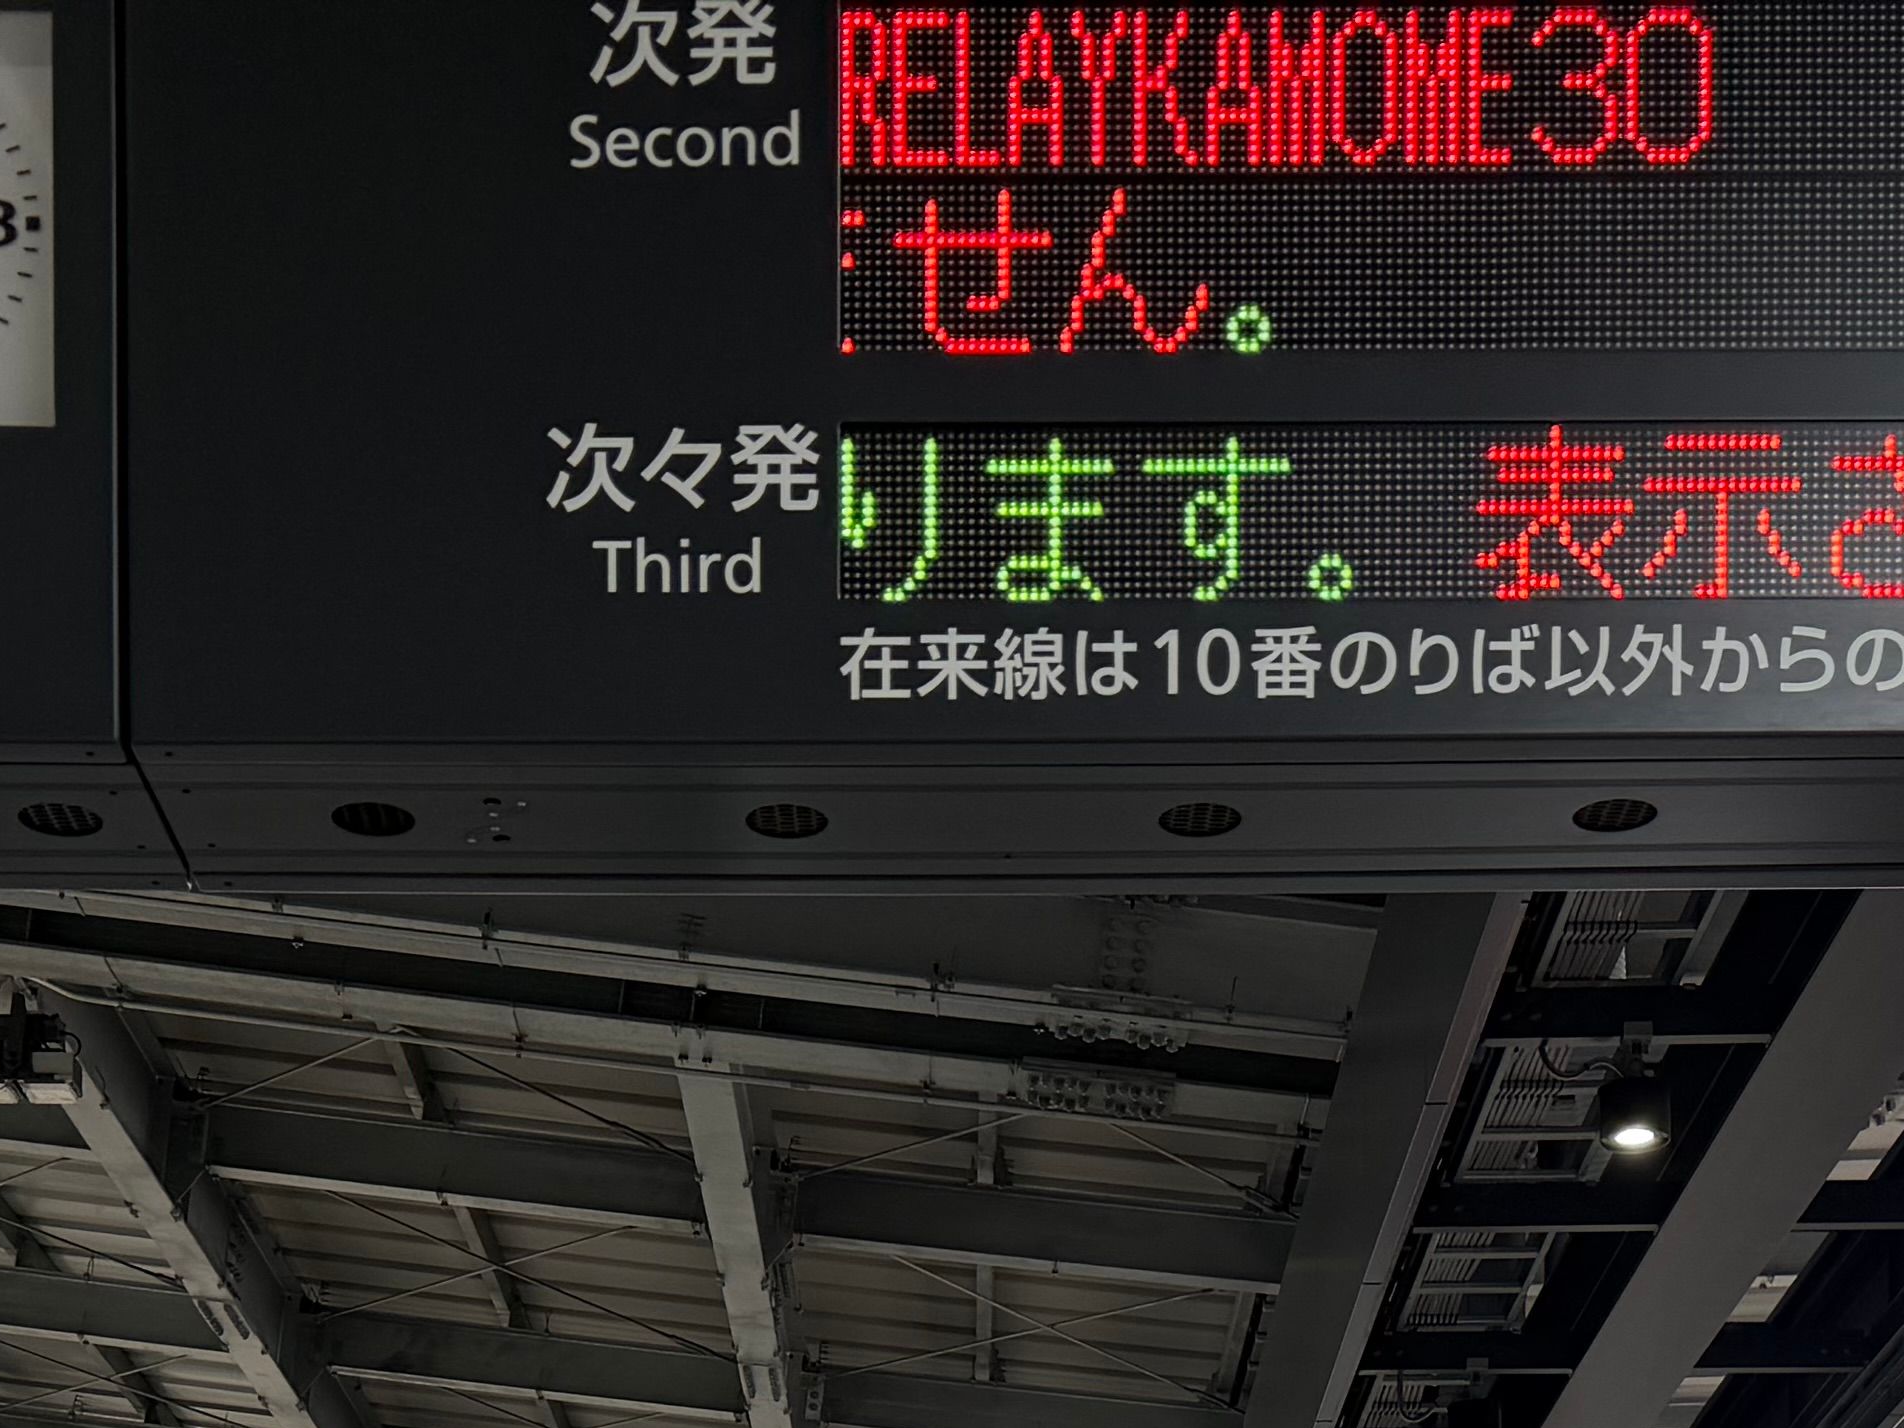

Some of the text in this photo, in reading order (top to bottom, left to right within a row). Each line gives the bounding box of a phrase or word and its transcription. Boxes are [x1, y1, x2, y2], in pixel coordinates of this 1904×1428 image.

[589, 0, 777, 87] 次発
[569, 112, 801, 168] Second
[840, 188, 1274, 354] せん。
[545, 424, 822, 514] 次々発
[592, 537, 764, 597] Third
